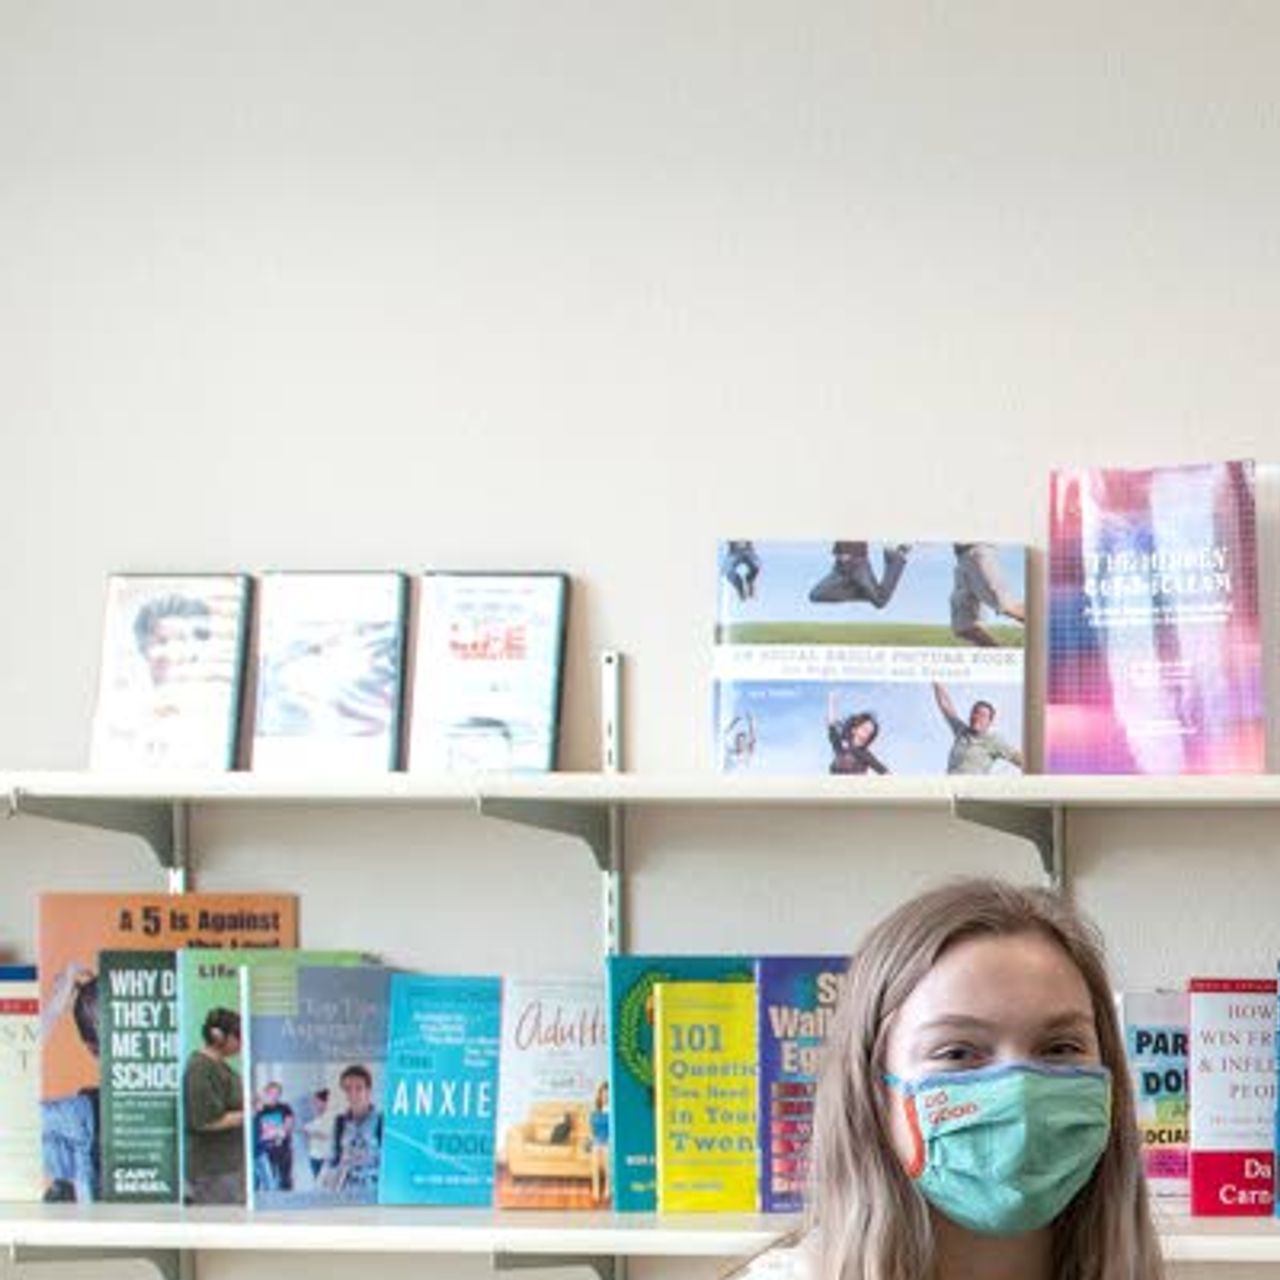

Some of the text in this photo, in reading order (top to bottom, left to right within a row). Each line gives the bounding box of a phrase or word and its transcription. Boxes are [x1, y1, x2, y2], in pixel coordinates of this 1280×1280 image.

[143, 906, 161, 935] 5
[199, 910, 279, 933] Against
[109, 970, 156, 997] WHY
[110, 1002, 162, 1027] THEY
[112, 1034, 142, 1058] ME
[669, 1024, 722, 1051] 101
[1201, 1031, 1240, 1045] WIN
[392, 1080, 491, 1118] ANXIE
